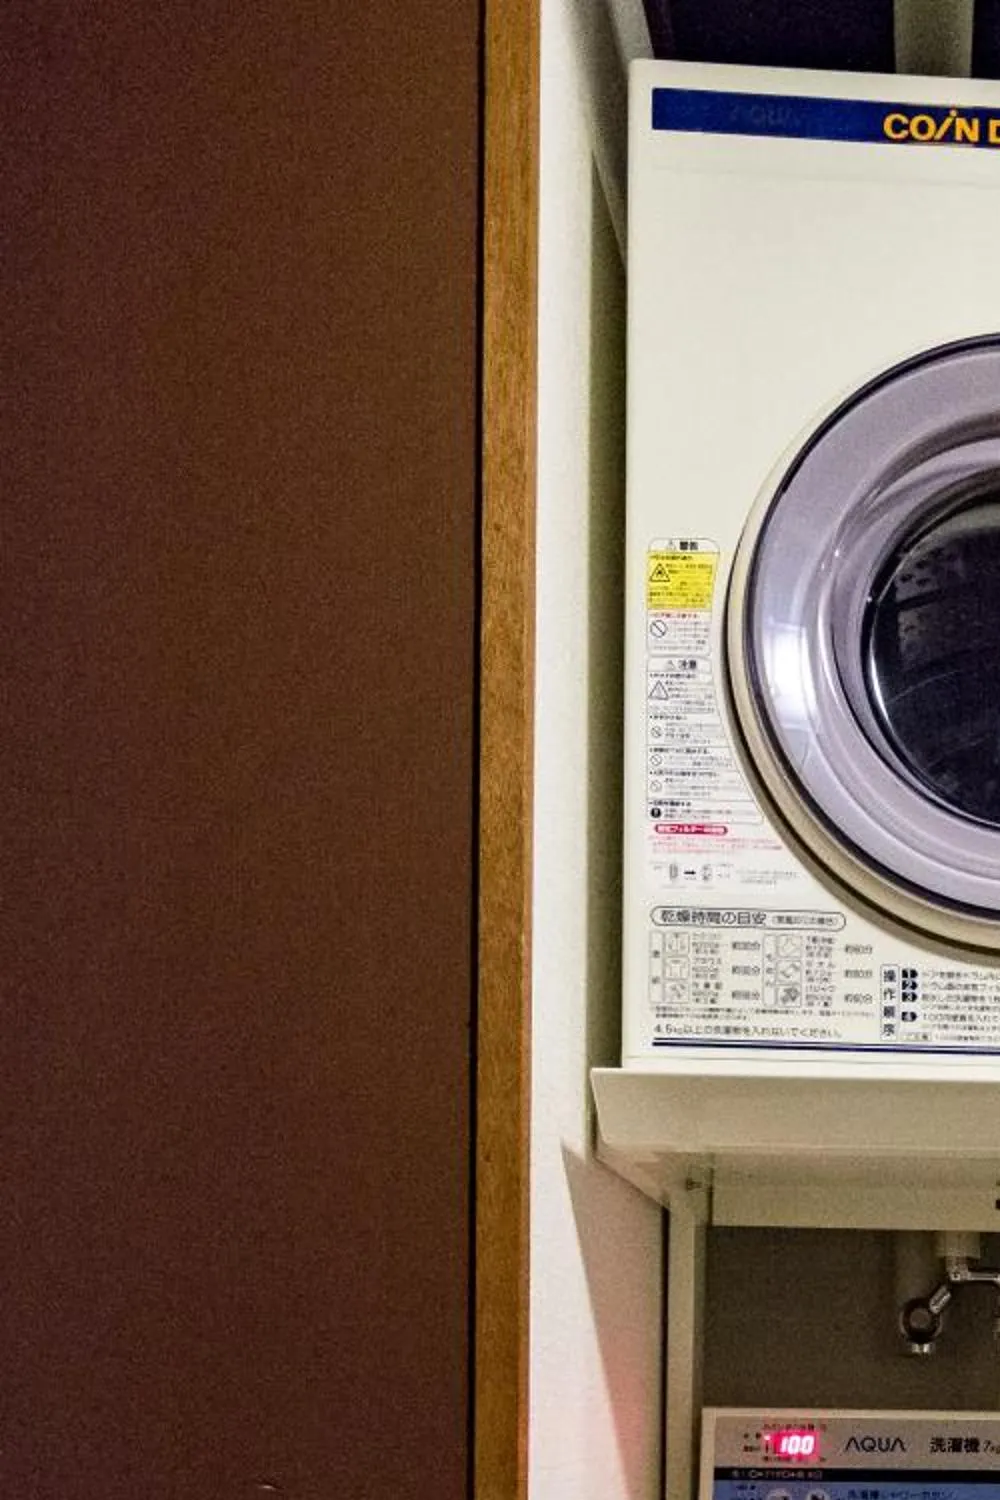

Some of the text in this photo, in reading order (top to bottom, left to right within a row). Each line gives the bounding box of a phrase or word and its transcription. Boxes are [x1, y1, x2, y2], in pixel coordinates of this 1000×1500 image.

[661, 909, 768, 926] 乾燥時間の目安
[781, 1435, 815, 1455] 100
[845, 1436, 907, 1453] AQUA
[930, 1436, 980, 1453] 洗濯機
